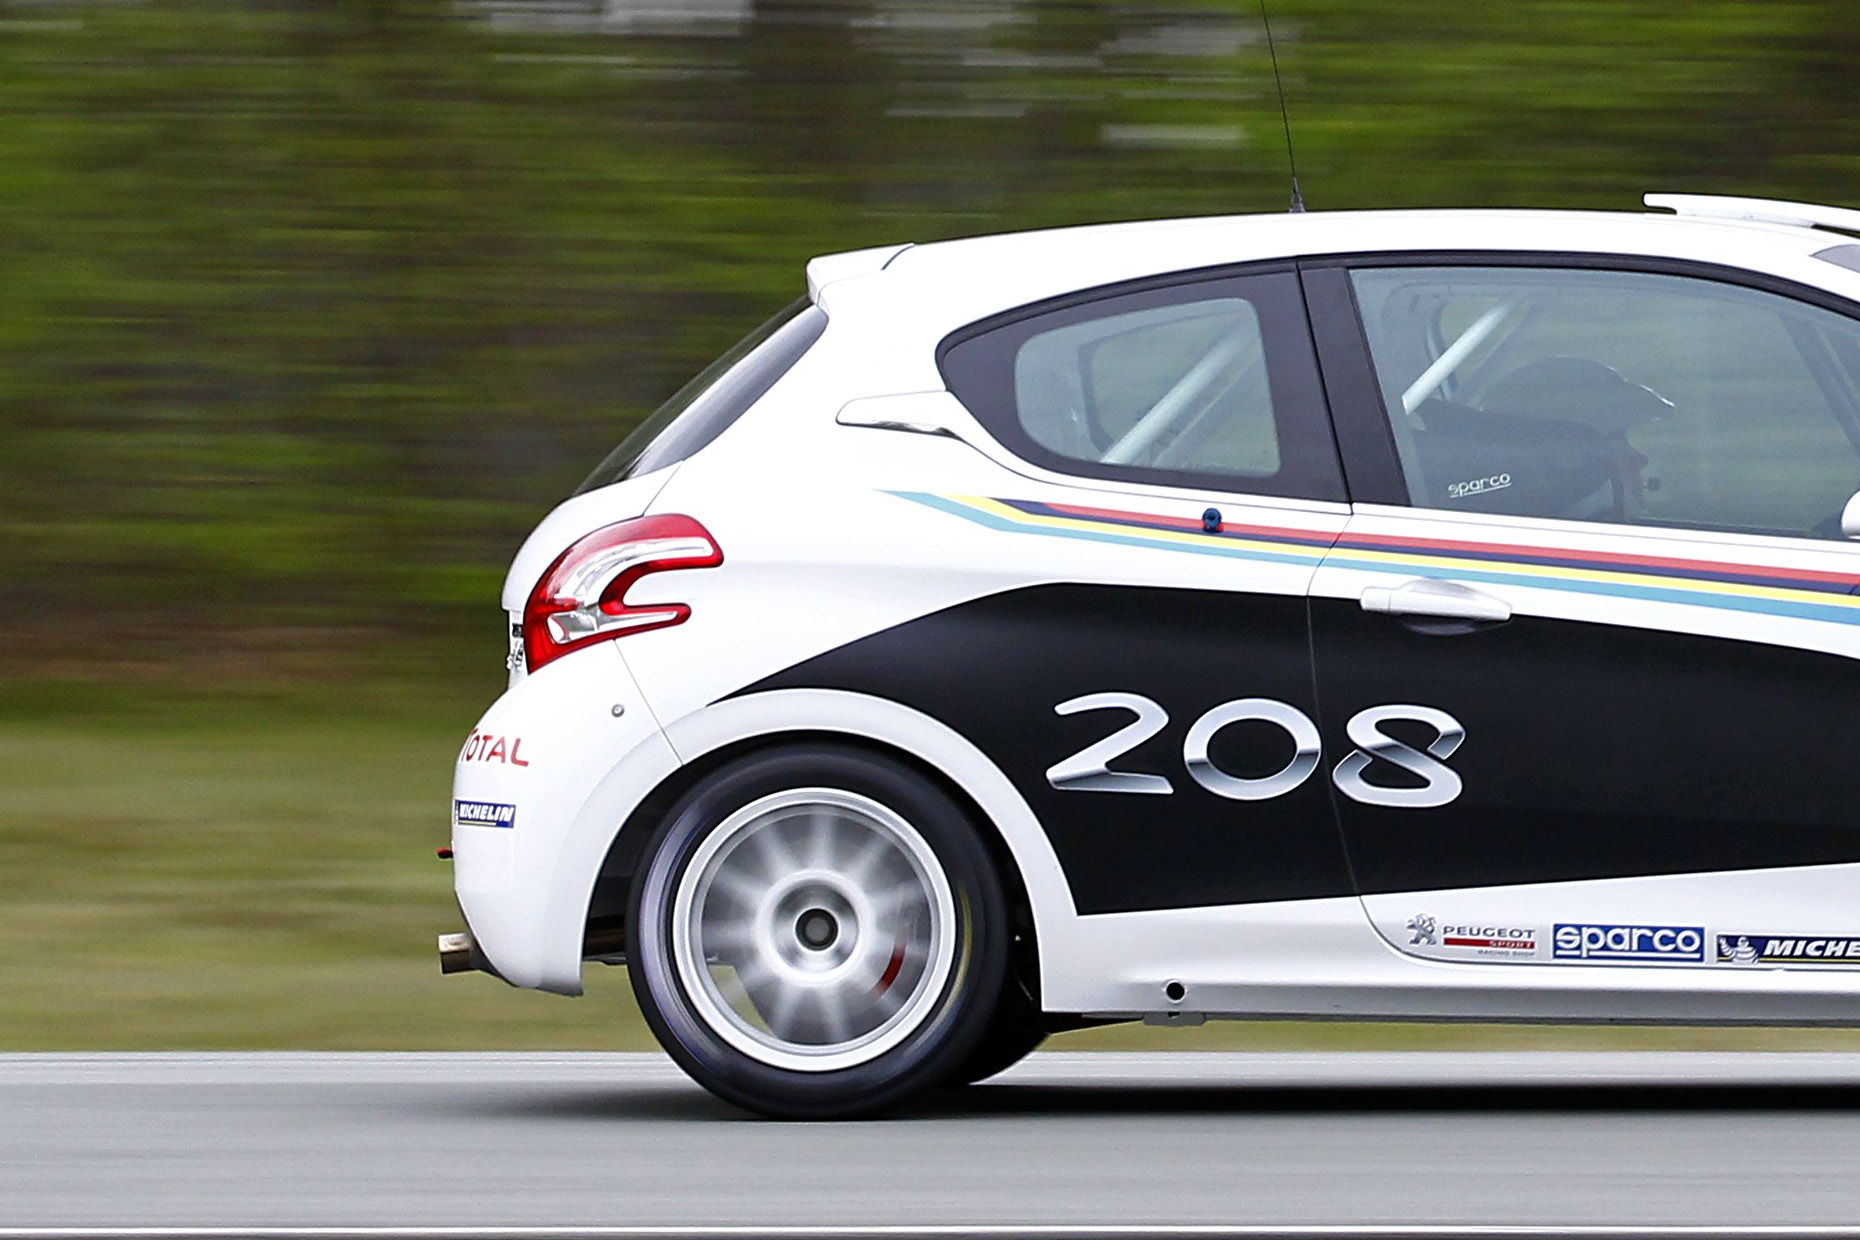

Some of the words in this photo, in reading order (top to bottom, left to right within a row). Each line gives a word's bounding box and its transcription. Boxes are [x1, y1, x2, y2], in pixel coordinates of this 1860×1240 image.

[1448, 473, 1511, 497] sparco
[461, 727, 529, 767] TOTAL
[1046, 691, 1466, 807] 208
[1443, 925, 1536, 939] PEUGEOT
[1489, 940, 1532, 949] SPORT
[1555, 926, 1701, 958] sparco
